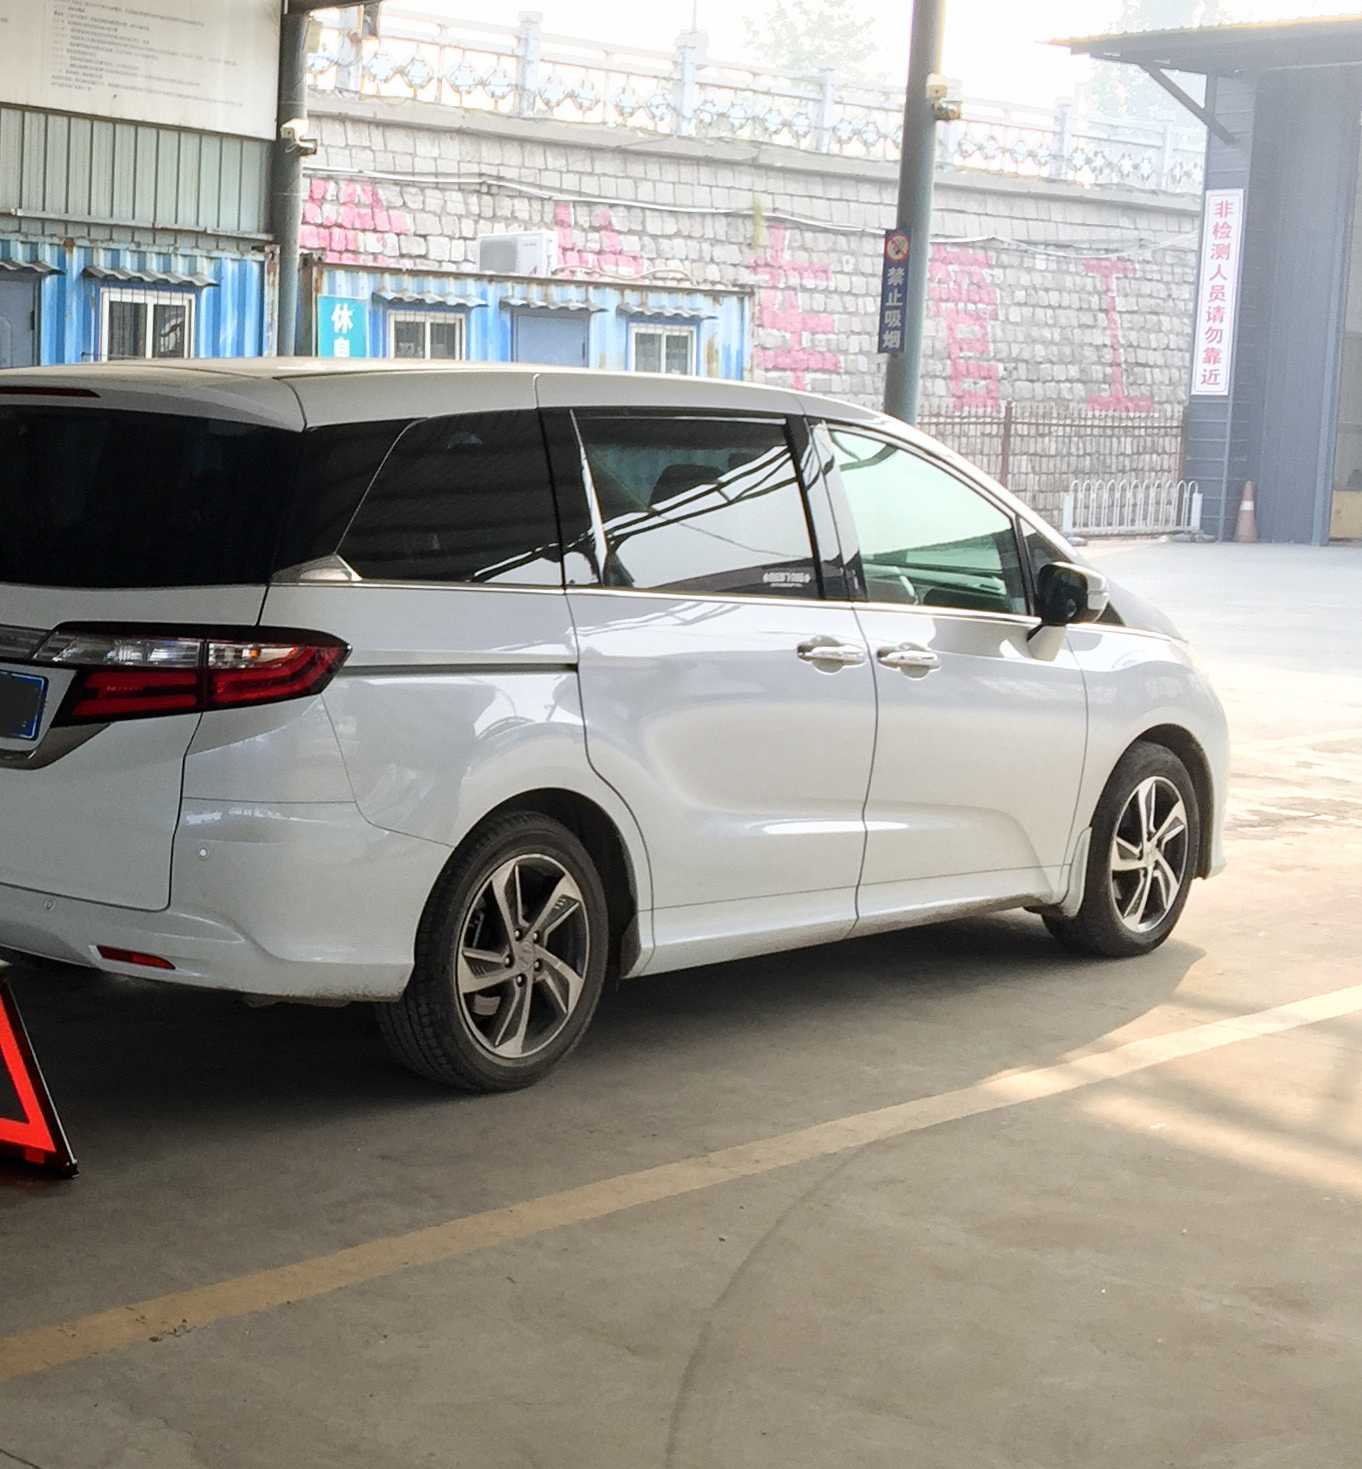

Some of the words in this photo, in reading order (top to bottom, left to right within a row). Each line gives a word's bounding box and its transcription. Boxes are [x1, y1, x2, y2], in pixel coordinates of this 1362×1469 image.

[882, 266, 906, 349] 禁止吸烟
[1200, 200, 1234, 386] 非检测人员请勿靠近
